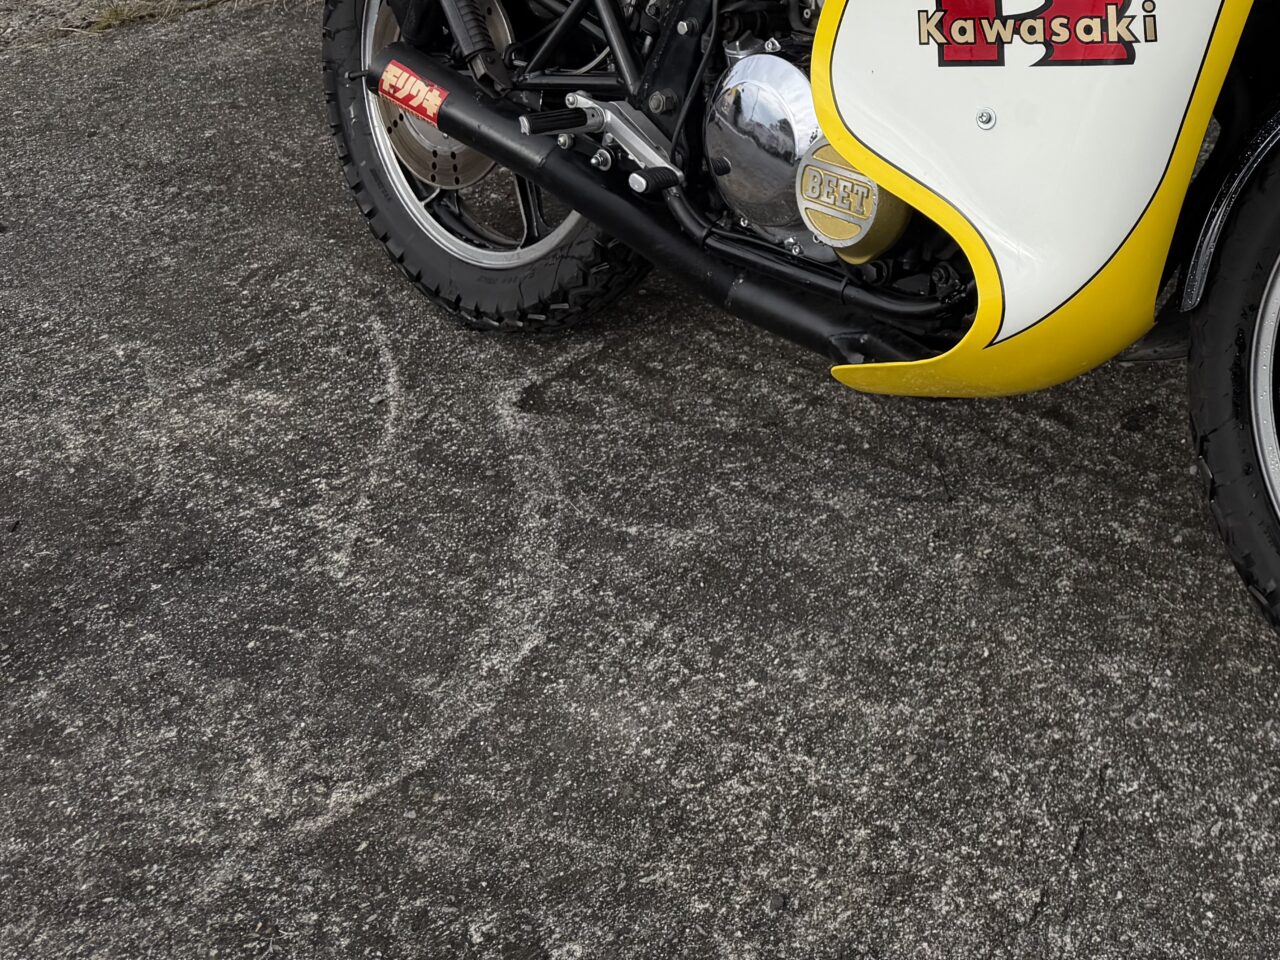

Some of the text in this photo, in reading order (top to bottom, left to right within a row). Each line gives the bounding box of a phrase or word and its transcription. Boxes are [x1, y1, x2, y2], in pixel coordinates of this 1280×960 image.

[381, 62, 442, 118] モリワキ
[806, 169, 870, 215] BEET
